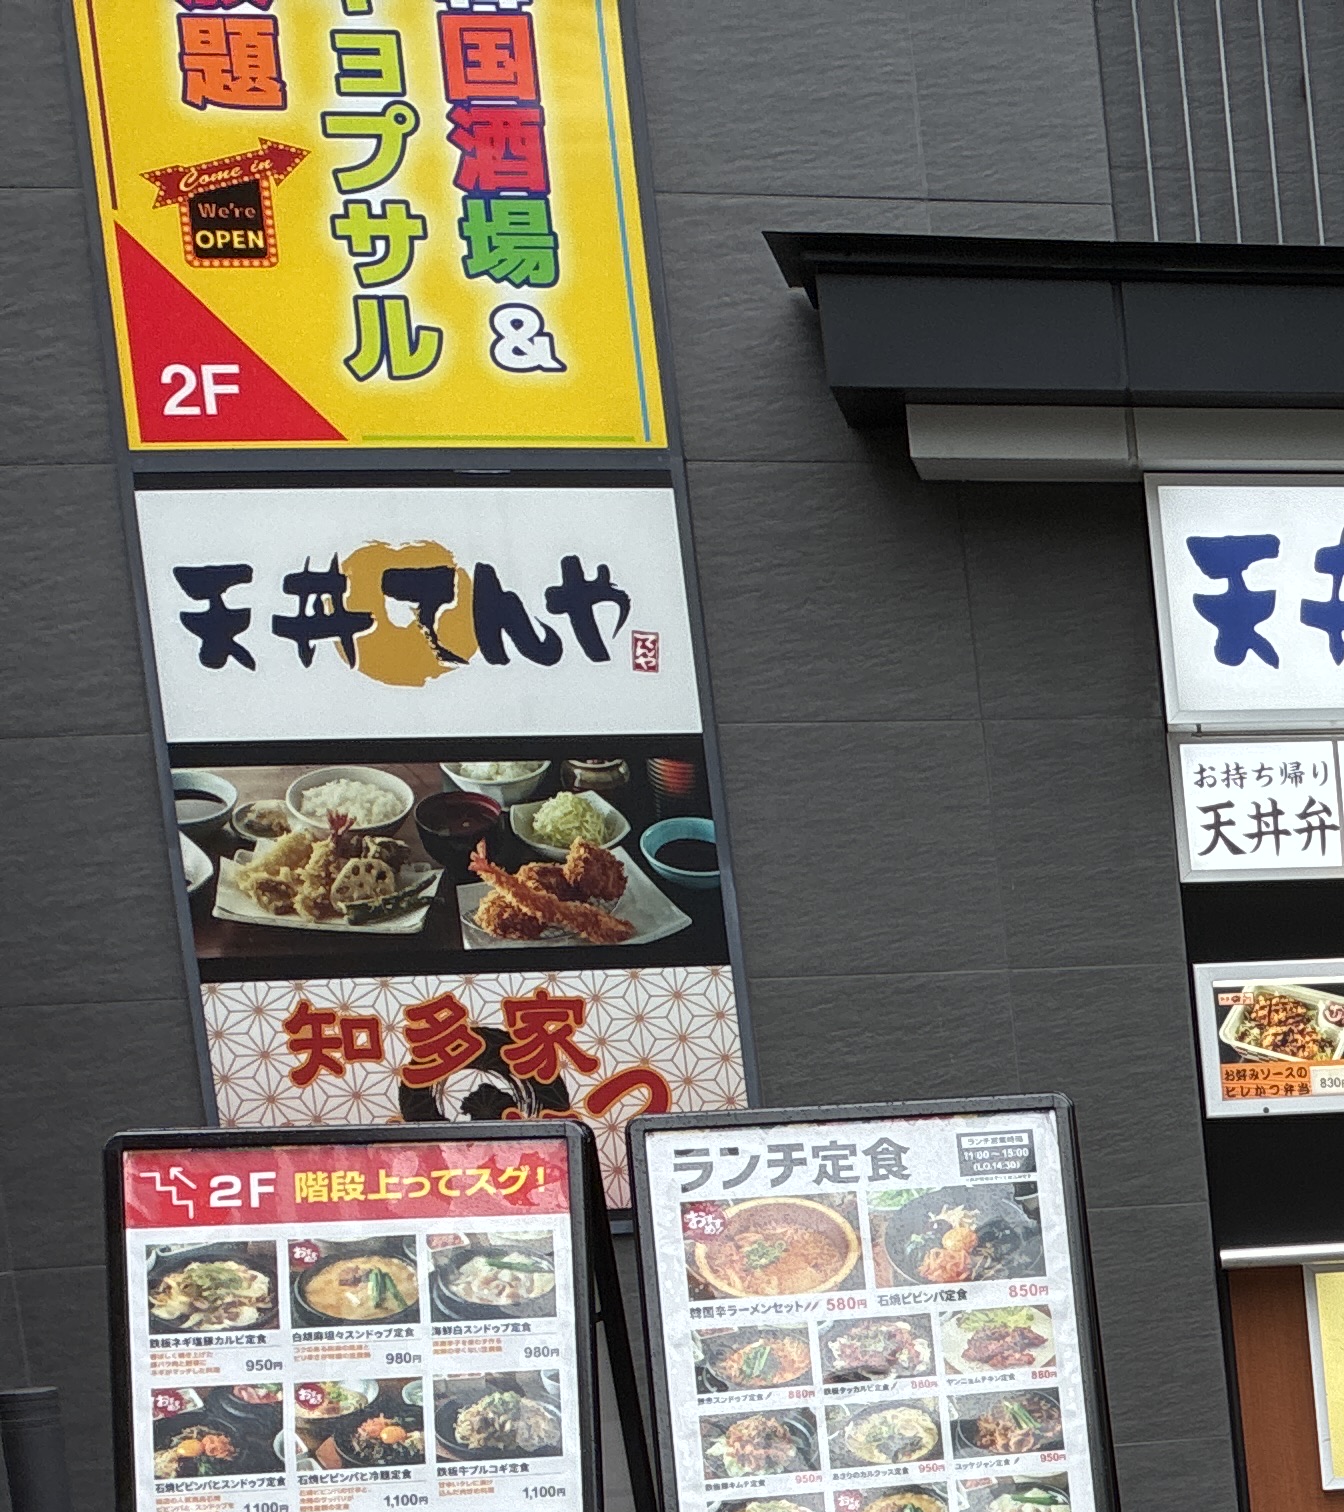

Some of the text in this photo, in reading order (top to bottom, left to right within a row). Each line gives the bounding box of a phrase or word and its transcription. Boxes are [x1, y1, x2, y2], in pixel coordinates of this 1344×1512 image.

[179, 159, 273, 192] Come in
[321, 0, 443, 381] ョプサル
[436, 0, 566, 373] 国酒場&
[198, 203, 256, 219] We're
[195, 230, 265, 249] OPEN
[160, 365, 240, 416] 2F
[173, 553, 631, 671] 天丼てんや
[1192, 761, 1330, 790] お持ち帰り
[1224, 1067, 1308, 1082] お好みソースの
[1225, 1082, 1311, 1098] ヒレかつ弁当
[672, 1136, 912, 1194] ランチ定食
[209, 1166, 545, 1208] 2F 階段上ってスグ!
[1008, 1284, 1049, 1298] 850円
[826, 1296, 868, 1311] 580円
[385, 1352, 422, 1365] 980円
[524, 1346, 560, 1359] 980円
[245, 1359, 283, 1372] 950円
[522, 1486, 566, 1500] 1,100円
[383, 1494, 429, 1509] 1,100円
